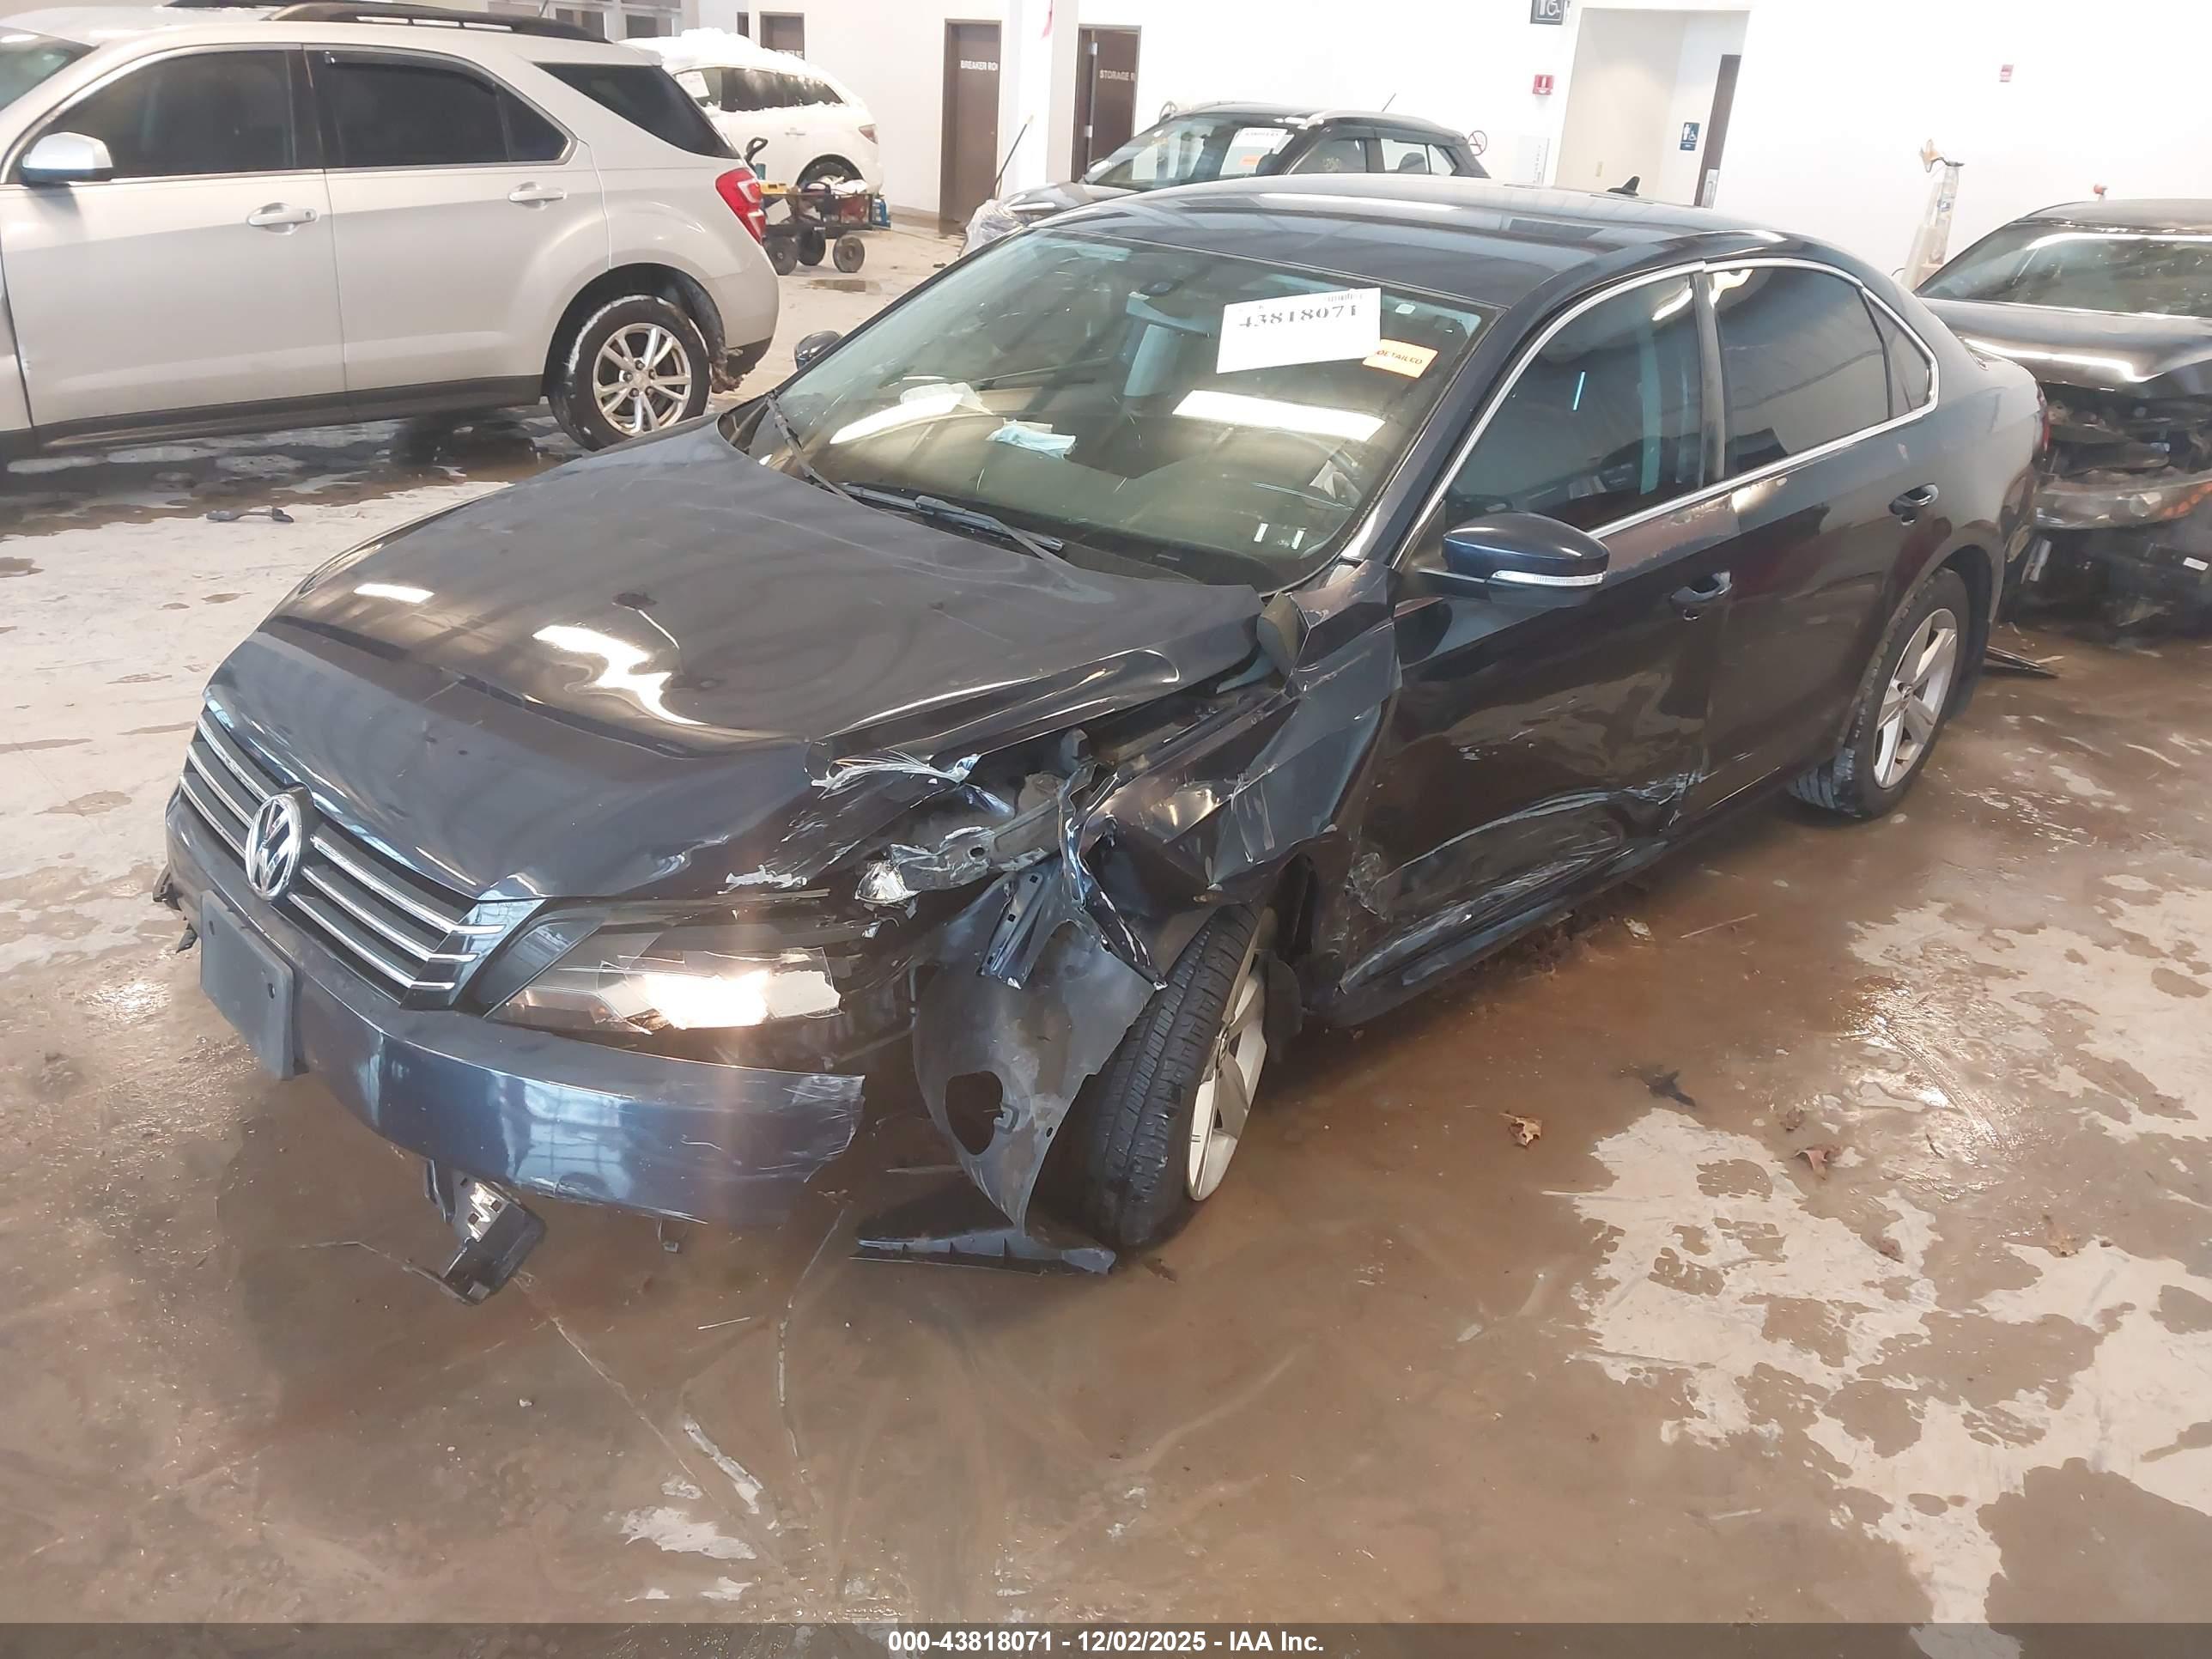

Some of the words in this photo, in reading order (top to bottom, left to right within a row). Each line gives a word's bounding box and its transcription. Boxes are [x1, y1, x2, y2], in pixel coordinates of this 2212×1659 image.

[961, 60, 987, 70] BREAKER
[1100, 70, 1128, 81] STORAGE
[1238, 304, 1357, 328] 43818071
